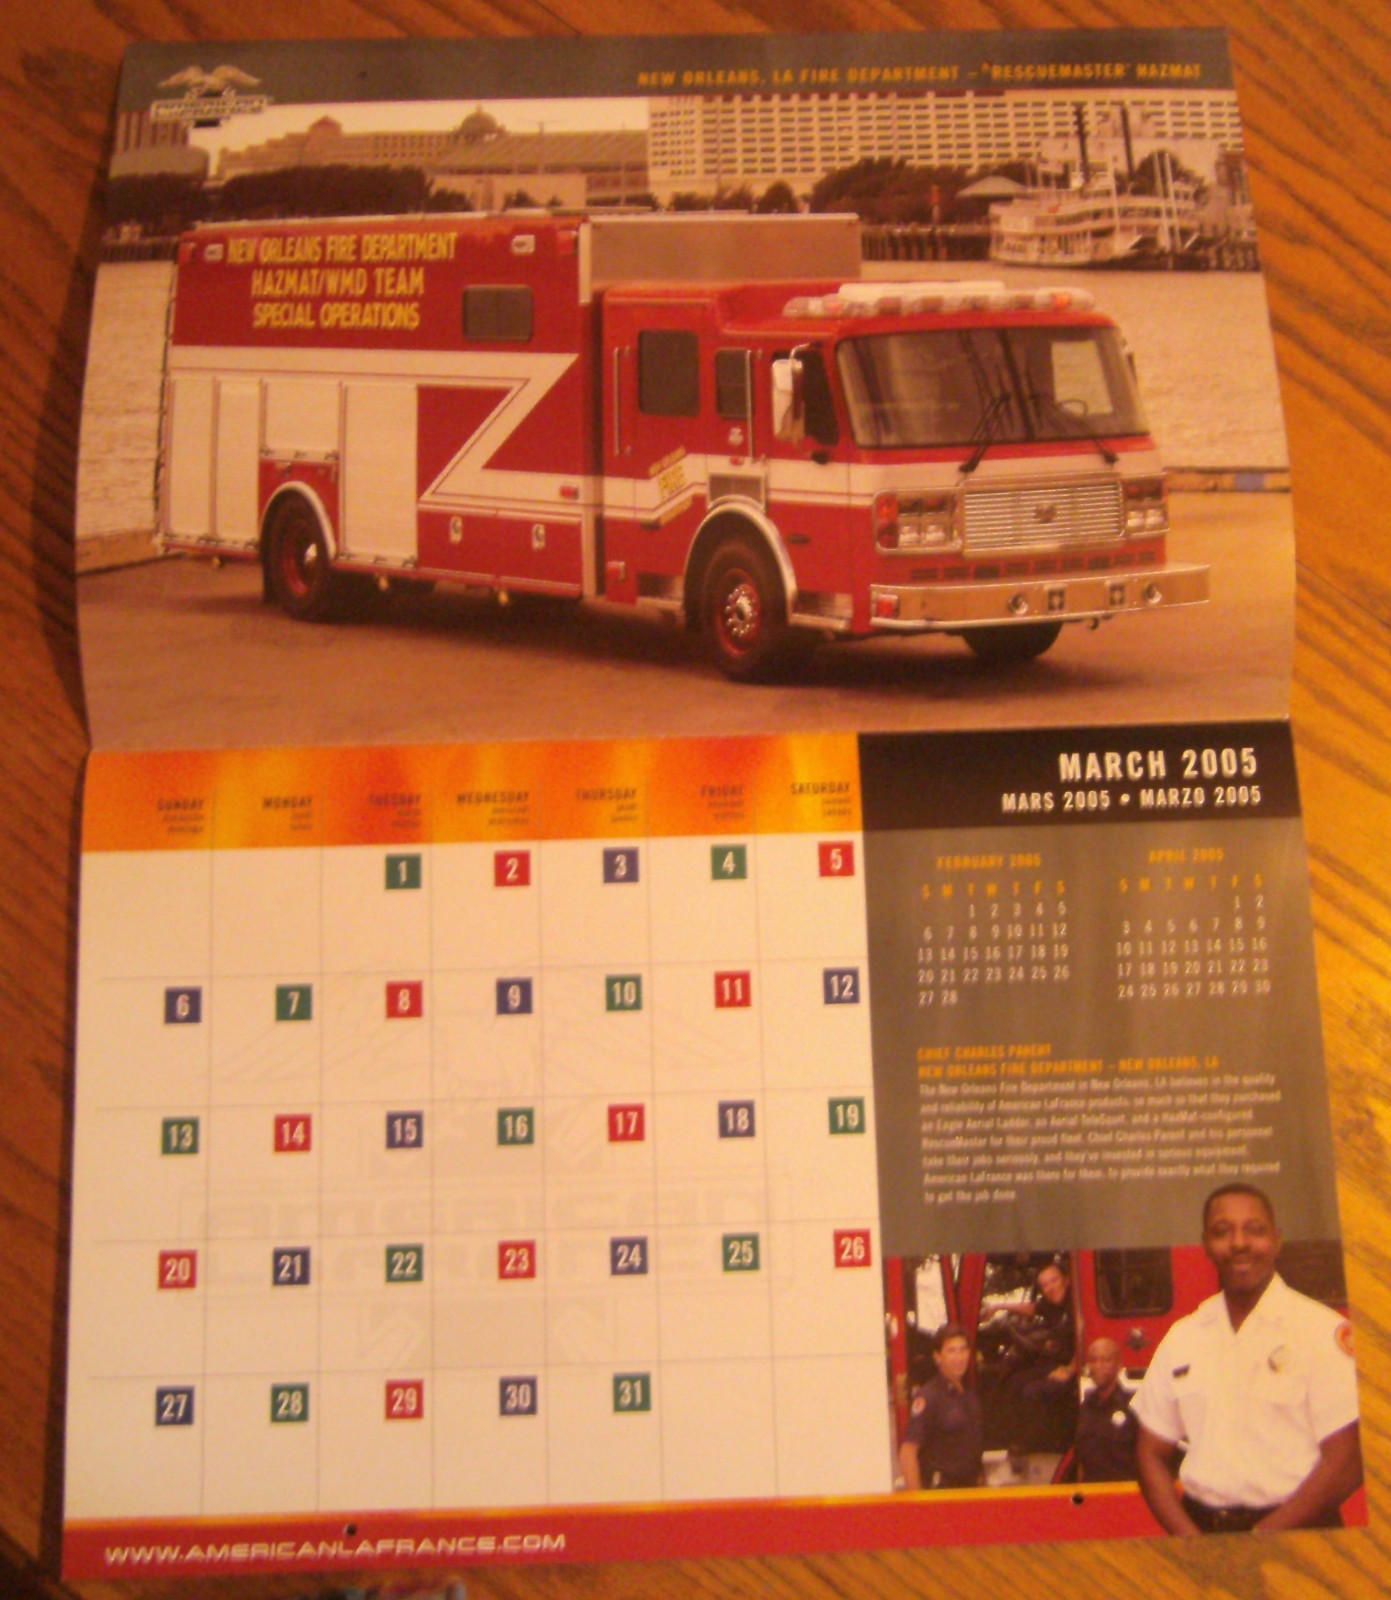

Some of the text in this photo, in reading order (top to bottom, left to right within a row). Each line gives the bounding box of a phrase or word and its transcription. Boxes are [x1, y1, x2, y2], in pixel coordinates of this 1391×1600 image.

[638, 72, 675, 85] NEW
[772, 69, 793, 83] LA
[800, 68, 839, 82] FIRE
[850, 66, 958, 82] DEPARTMENT
[1136, 63, 1200, 78] HAZMAT
[227, 233, 457, 263] NEW ORLEANS FIRE DEPARTMENT
[252, 268, 424, 296] HAZMAT/WMD TEAM
[253, 303, 419, 329] SPECIAL OPERATIONS
[1059, 748, 1256, 782] MARCH 2005
[369, 794, 420, 805] TUESDAY
[457, 791, 528, 804] WEDNESDAY
[575, 788, 637, 800] THURSDAY
[701, 785, 743, 796] FRIDAY
[790, 783, 850, 795] SATURDAY
[1003, 786, 1260, 813] MARS 2005 MARZO 2005
[158, 798, 204, 810] SUNDAY
[263, 796, 312, 809] MONDAY
[614, 854, 629, 880] 3
[722, 851, 737, 875] 4
[829, 848, 844, 873] 5
[937, 854, 1041, 869] FEBRUARY 2005
[1150, 848, 1224, 864] APRIL 2005
[398, 860, 408, 885] 1
[506, 857, 520, 883] 2
[919, 945, 1068, 962] 13 14 15 16 17 18 19
[1117, 938, 1267, 956] 10 11 12 13 14 15 16
[919, 966, 1069, 984] 20 21 22 23 24 25 26
[1118, 959, 1268, 977] 17 18 19 20 21 22 23
[507, 984, 522, 1012] 9
[613, 981, 636, 1007] 10
[722, 978, 743, 1003] 11
[830, 974, 854, 1000] 12
[920, 990, 957, 1005] 27 28
[1119, 980, 1270, 998] 24 25 26 27 28 29 30
[175, 993, 191, 1021] 6
[288, 991, 301, 1017] 7
[397, 988, 412, 1014] 8
[919, 1065, 943, 1078] NEW
[947, 1064, 996, 1077] ORLEANS
[1001, 1063, 1026, 1075] FIRE
[1030, 1060, 1102, 1074] DEPARTMENT
[504, 1114, 528, 1141] 16
[615, 1111, 638, 1137] 17
[726, 1107, 750, 1133] 18
[836, 1103, 860, 1130] 19
[168, 1124, 193, 1151] 13
[282, 1121, 306, 1147] 14
[393, 1118, 418, 1145] 15
[504, 1247, 530, 1276] 23
[616, 1244, 642, 1271] 24
[728, 1240, 754, 1268] 25
[840, 1236, 865, 1264] 26
[164, 1257, 191, 1285] 20
[278, 1254, 302, 1282] 21
[391, 1251, 417, 1279] 22
[276, 1390, 303, 1419] 28
[391, 1387, 417, 1416] 29
[505, 1383, 532, 1412] 30
[619, 1379, 642, 1408] 31
[161, 1393, 188, 1422] 27
[105, 1534, 565, 1564] WWW.AMERICANLAFRANCE.COM
